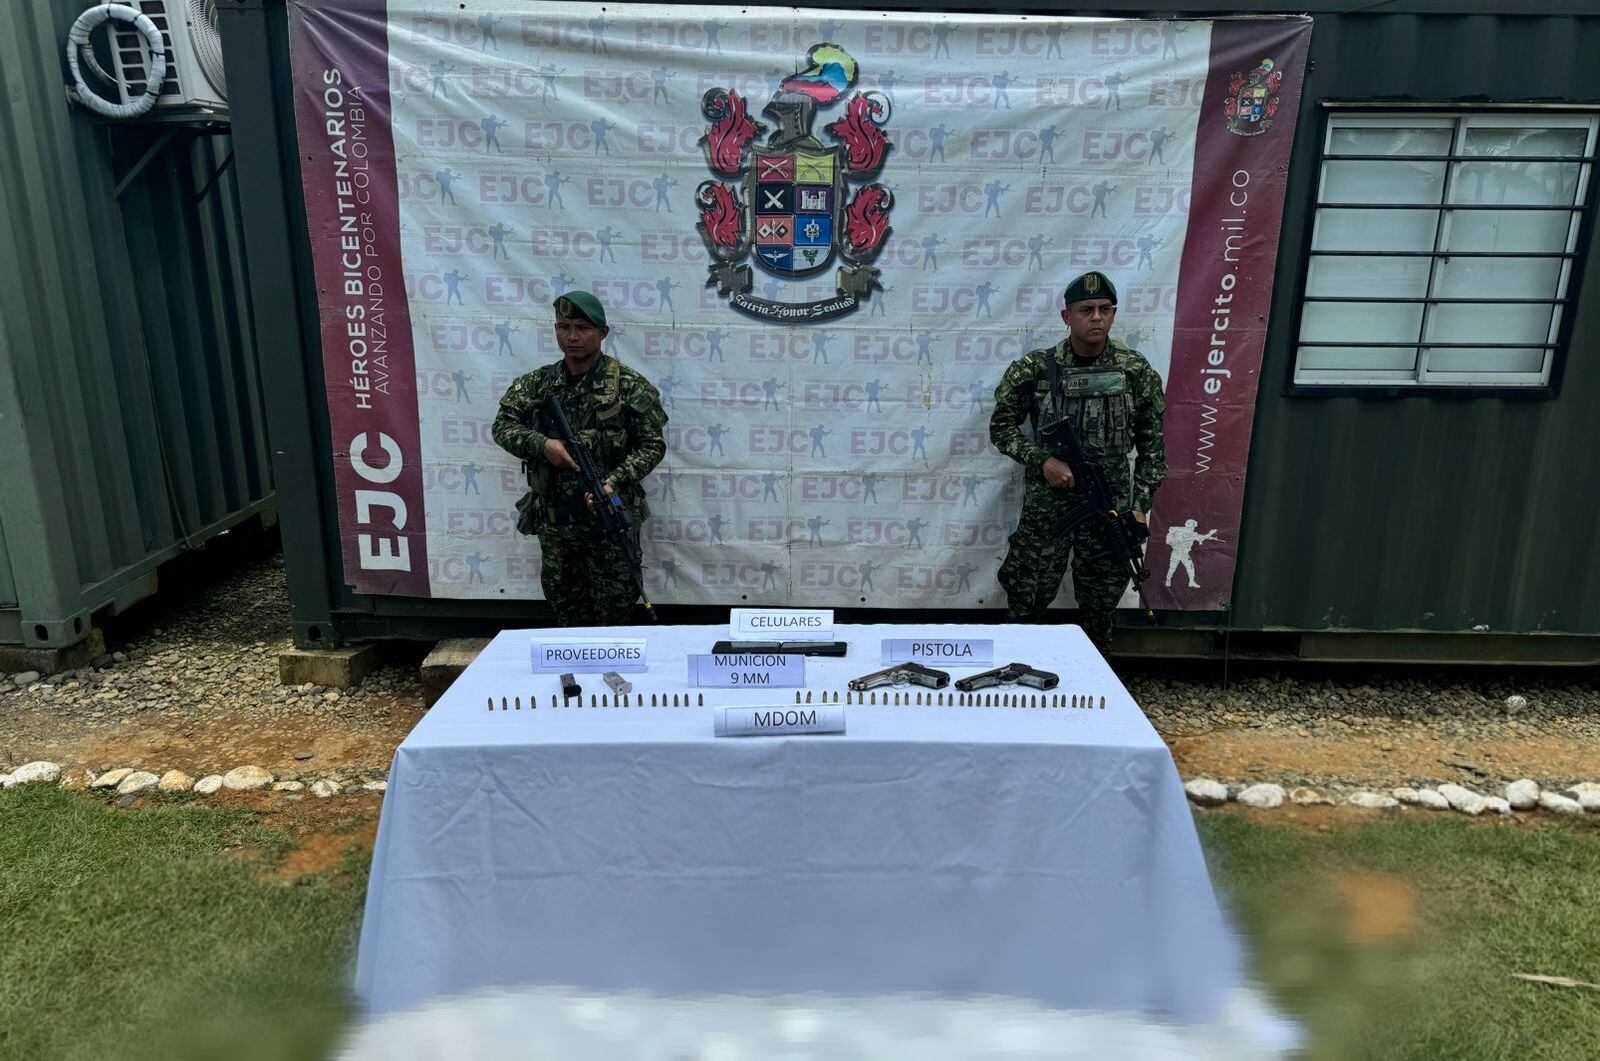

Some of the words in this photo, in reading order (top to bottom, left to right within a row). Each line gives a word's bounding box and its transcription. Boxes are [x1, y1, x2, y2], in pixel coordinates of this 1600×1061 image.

[521, 18, 587, 48] EJC
[635, 22, 701, 49] EJC
[750, 24, 818, 50] EJC
[865, 25, 932, 54] EJC
[976, 27, 1043, 55] EJC
[1092, 27, 1160, 55] EJC
[472, 67, 539, 98] EJC
[584, 70, 650, 99] EJC
[924, 76, 991, 104] EJC
[1035, 79, 1103, 107] EJC
[347, 86, 370, 203] COLOMBIA
[416, 119, 483, 148] EJC
[525, 122, 591, 150] EJC
[637, 126, 700, 153] EJC
[971, 129, 1038, 159] EJC
[1082, 132, 1150, 160] EJC
[323, 68, 364, 295] BICENTENARIOS
[479, 175, 544, 204] EJC
[587, 178, 651, 207] EJC
[918, 185, 983, 213] EJC
[1024, 186, 1091, 214] EJC
[361, 213, 380, 257] POR
[424, 227, 489, 254] EJC
[531, 230, 596, 257] EJC
[641, 233, 704, 261] EJC
[962, 239, 1027, 266] EJC
[1070, 239, 1136, 266] EJC
[485, 276, 549, 304] EJC
[912, 287, 977, 314] EJC
[367, 265, 390, 395] AVANZANDO
[1195, 169, 1250, 475] www.ejercito.mil.co
[430, 325, 496, 351] EJC
[644, 331, 706, 357] EJC
[750, 334, 811, 360] EJC
[853, 336, 915, 361] EJC
[955, 336, 1018, 362] EJC
[346, 304, 372, 409] HÉROES
[701, 382, 761, 406] EJC
[804, 384, 865, 408] EJC
[906, 385, 967, 409] EJC
[749, 430, 809, 453] EJC
[851, 431, 910, 456] EJC
[702, 475, 761, 499] EJC
[802, 476, 861, 500] EJC
[902, 478, 962, 501] EJC
[350, 432, 411, 572] EJC
[447, 512, 510, 536] EJC
[649, 519, 707, 542] EJC
[748, 519, 807, 542] EJC
[848, 521, 907, 545] EJC
[944, 523, 1002, 547] EJC
[702, 563, 760, 586] EJC
[801, 565, 859, 587] EJC
[898, 567, 957, 590] EJC
[750, 616, 822, 627] CELULARES
[546, 648, 641, 661] PROVEEDORES
[714, 655, 786, 667] MUNICION
[912, 643, 973, 657] PISTOLA
[731, 672, 739, 684] 9
[743, 673, 770, 684] MM
[754, 710, 817, 727] MDOM
